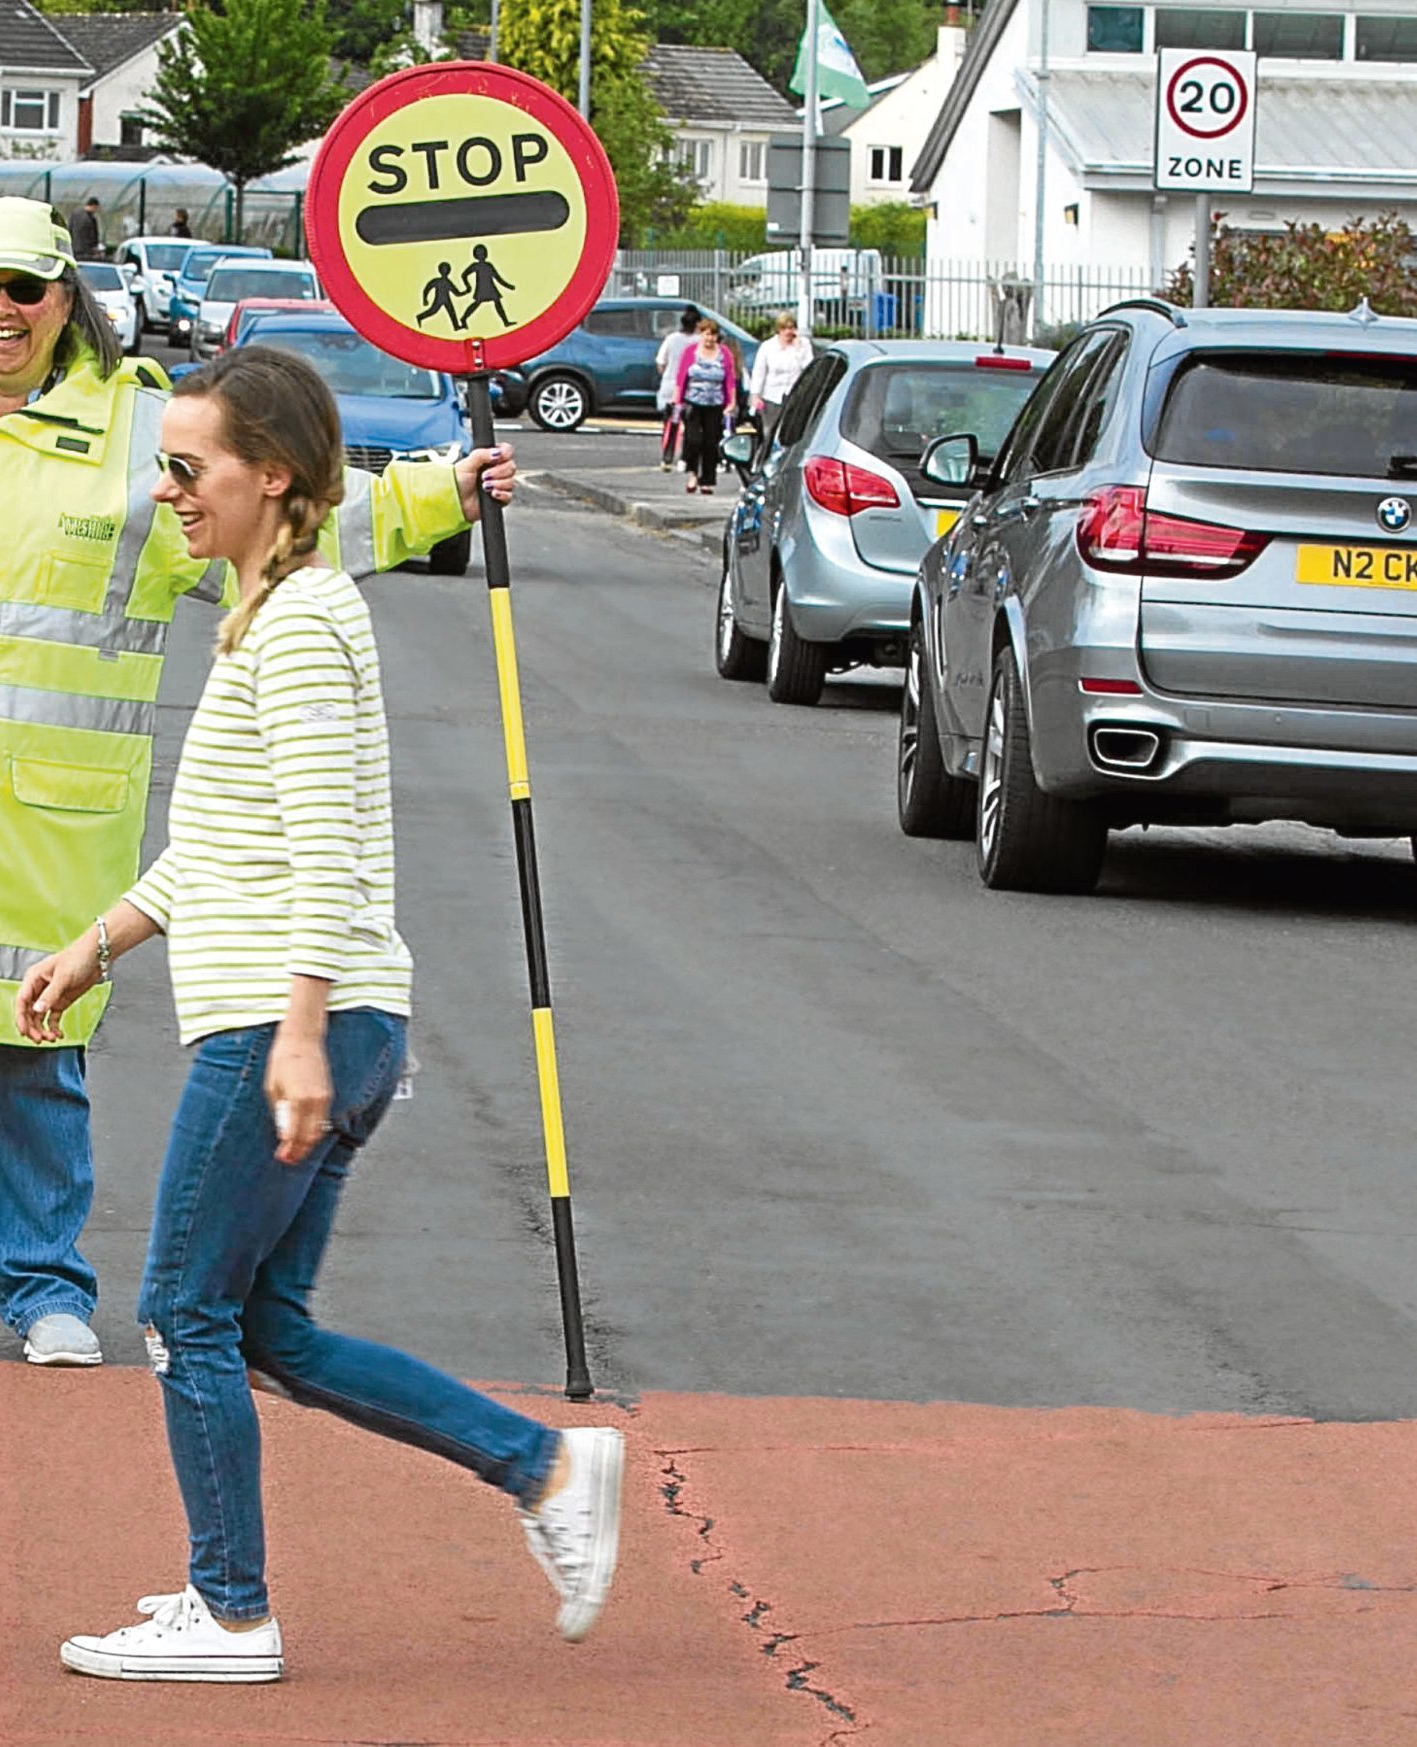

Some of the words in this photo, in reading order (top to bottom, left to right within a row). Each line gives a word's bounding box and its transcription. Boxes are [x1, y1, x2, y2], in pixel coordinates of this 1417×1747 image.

[1180, 80, 1235, 115] 20
[367, 133, 548, 195] STOP
[1168, 157, 1242, 179] ZONE
[1333, 550, 1373, 579] N2
